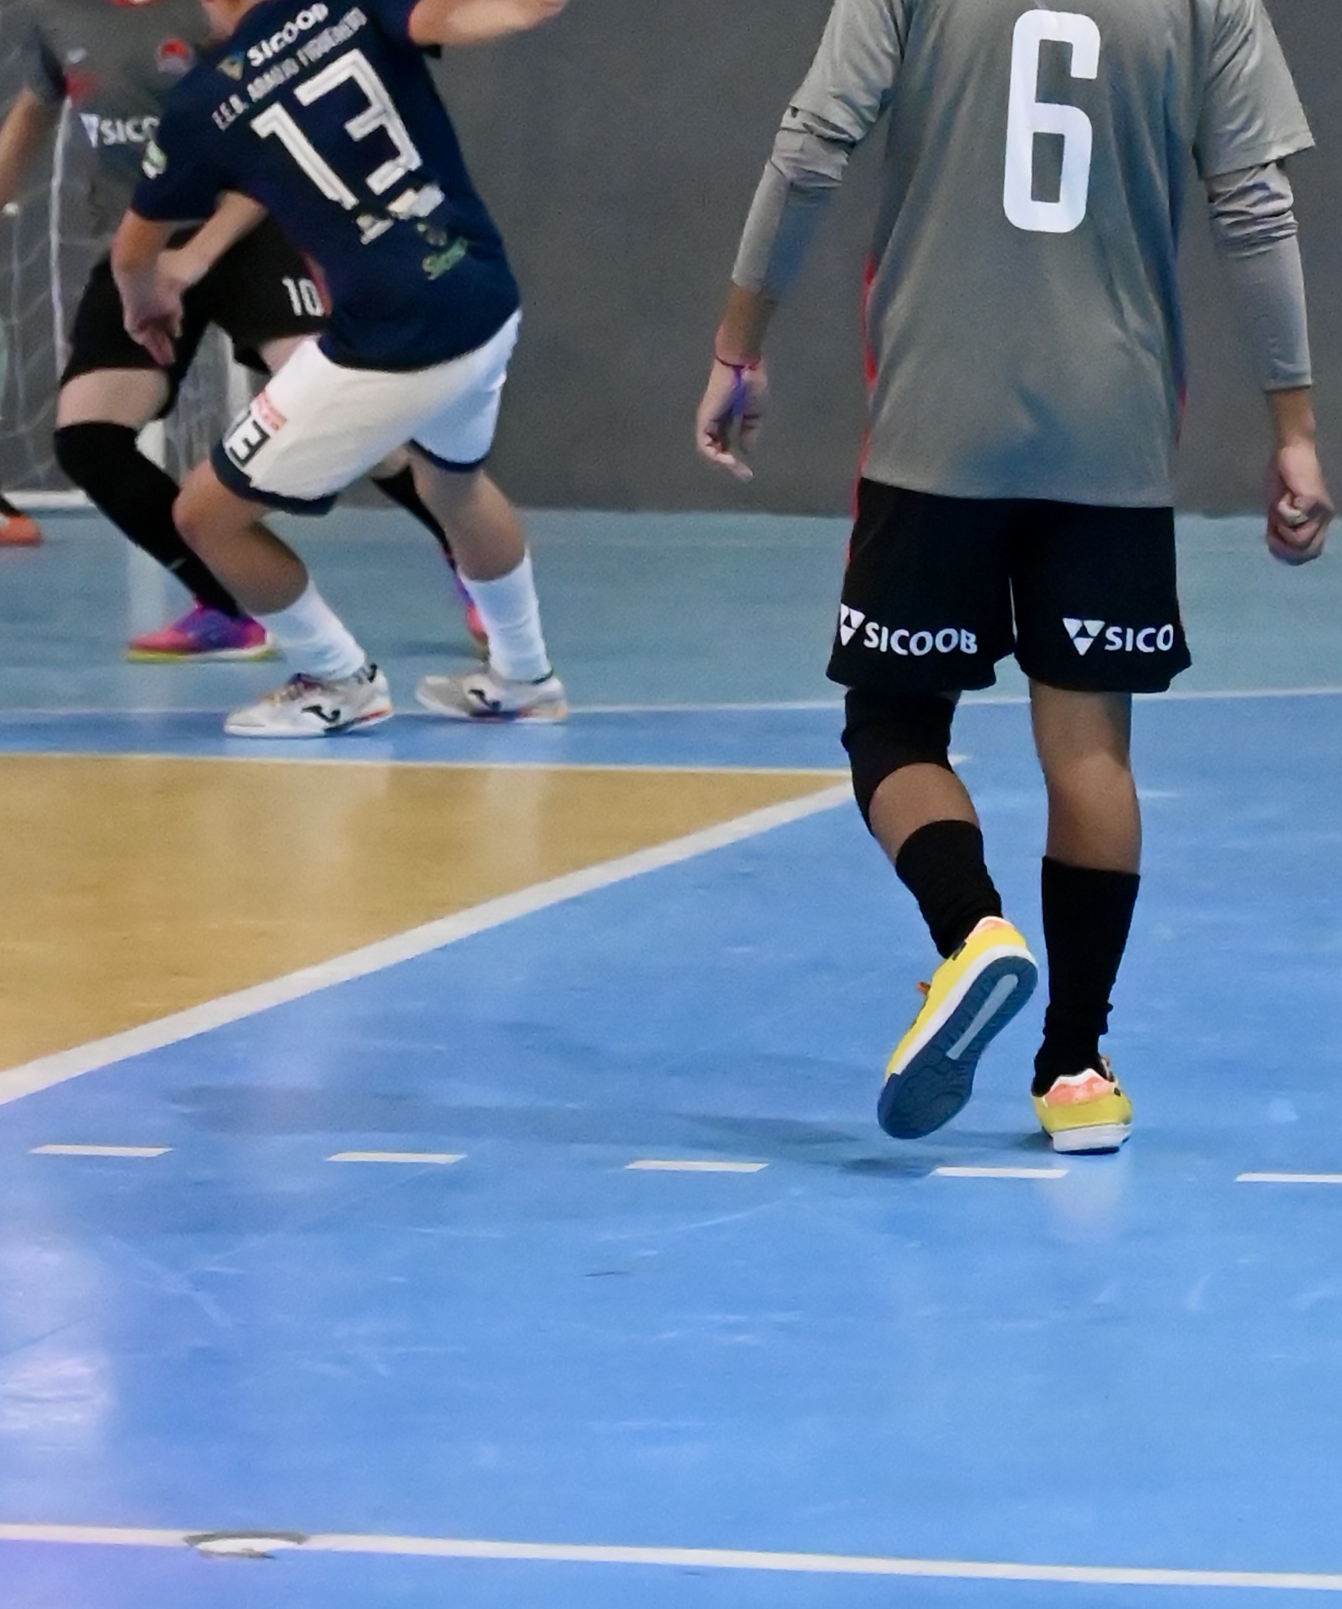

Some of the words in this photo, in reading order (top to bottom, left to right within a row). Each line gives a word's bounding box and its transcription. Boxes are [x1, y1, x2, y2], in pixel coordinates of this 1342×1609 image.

[250, 47, 423, 211] 13
[1003, 8, 1101, 234] 6
[282, 276, 325, 317] 10
[863, 621, 978, 657] SICOOB
